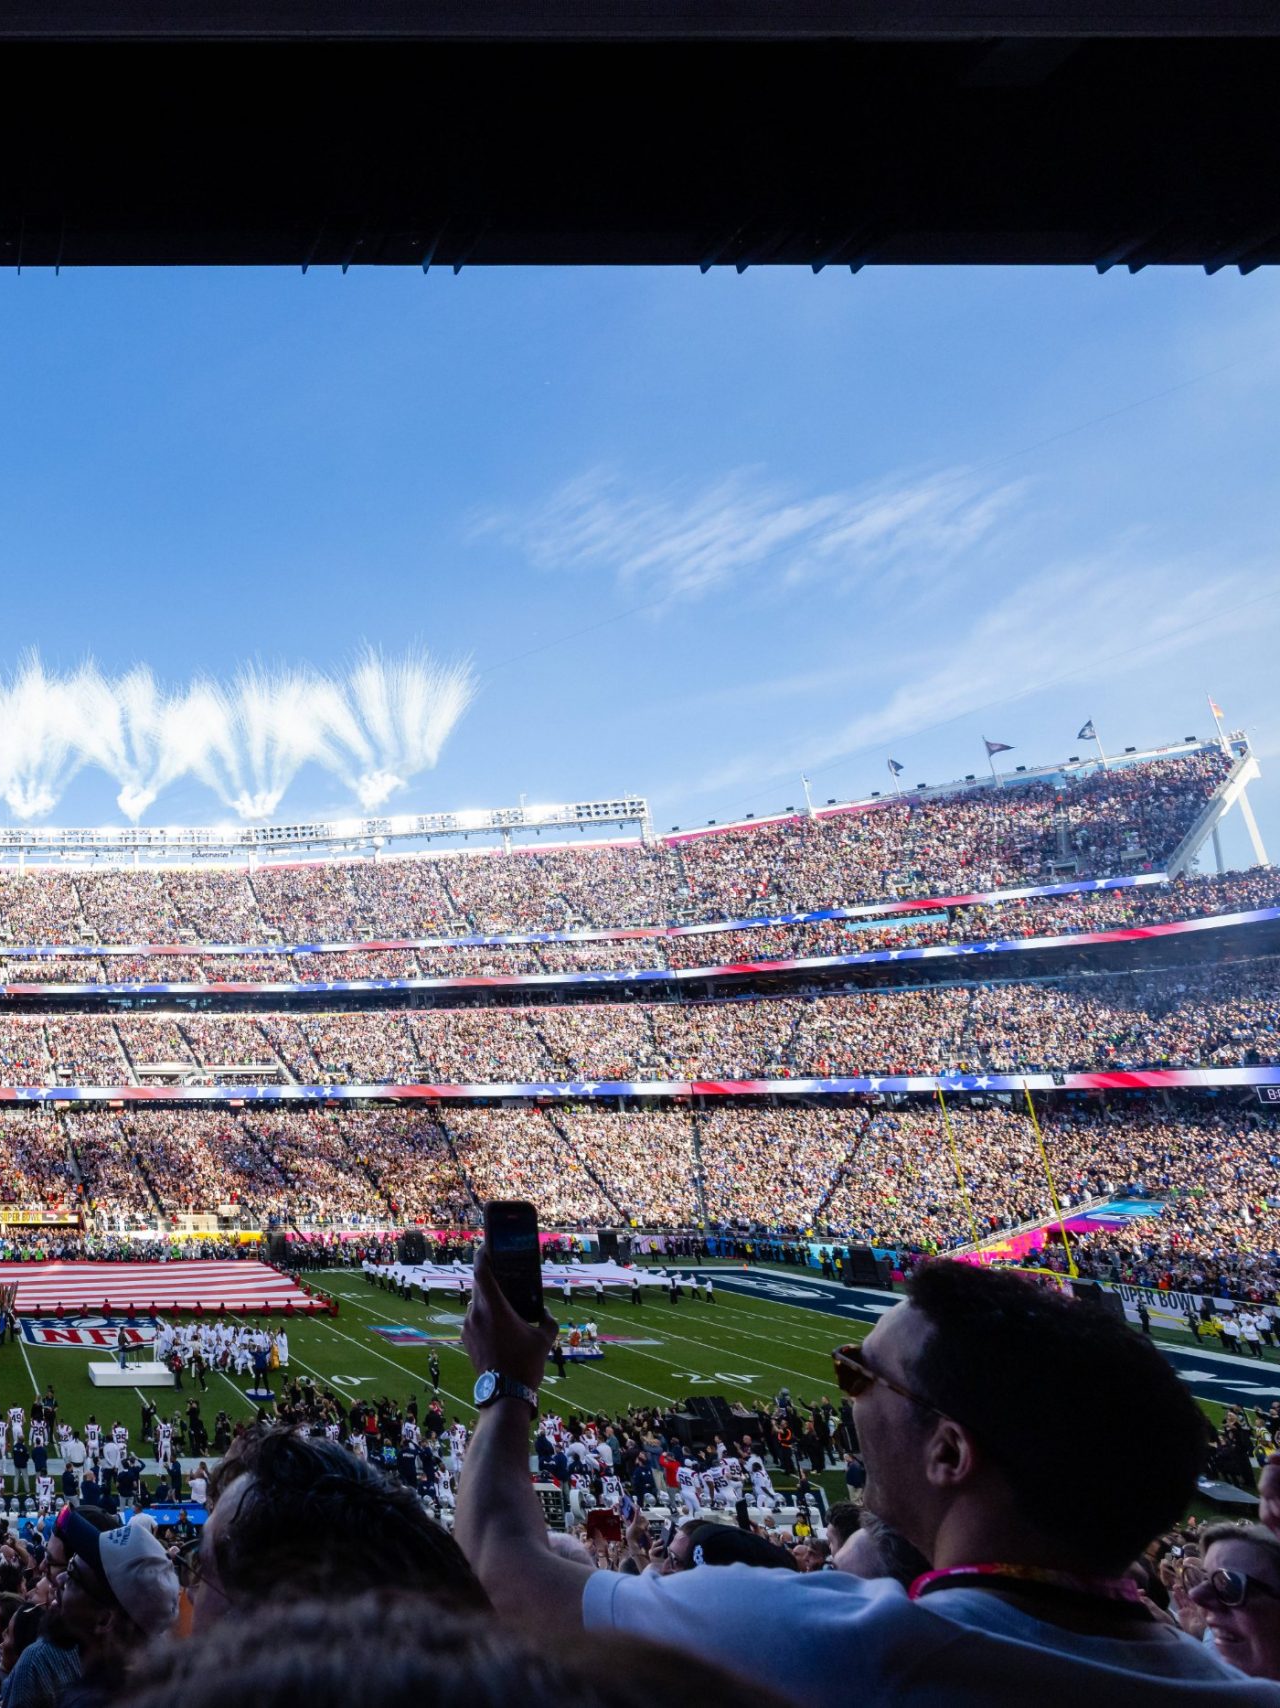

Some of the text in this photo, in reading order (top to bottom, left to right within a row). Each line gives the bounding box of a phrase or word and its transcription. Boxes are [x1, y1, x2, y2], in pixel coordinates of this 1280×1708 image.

[0, 1213, 20, 1222] SUPER
[1111, 1284, 1200, 1312] SUPER BOWL
[38, 1328, 156, 1347] NFL
[671, 1372, 753, 1384] 20
[42, 1484, 49, 1495] 7
[606, 1482, 620, 1493] 34
